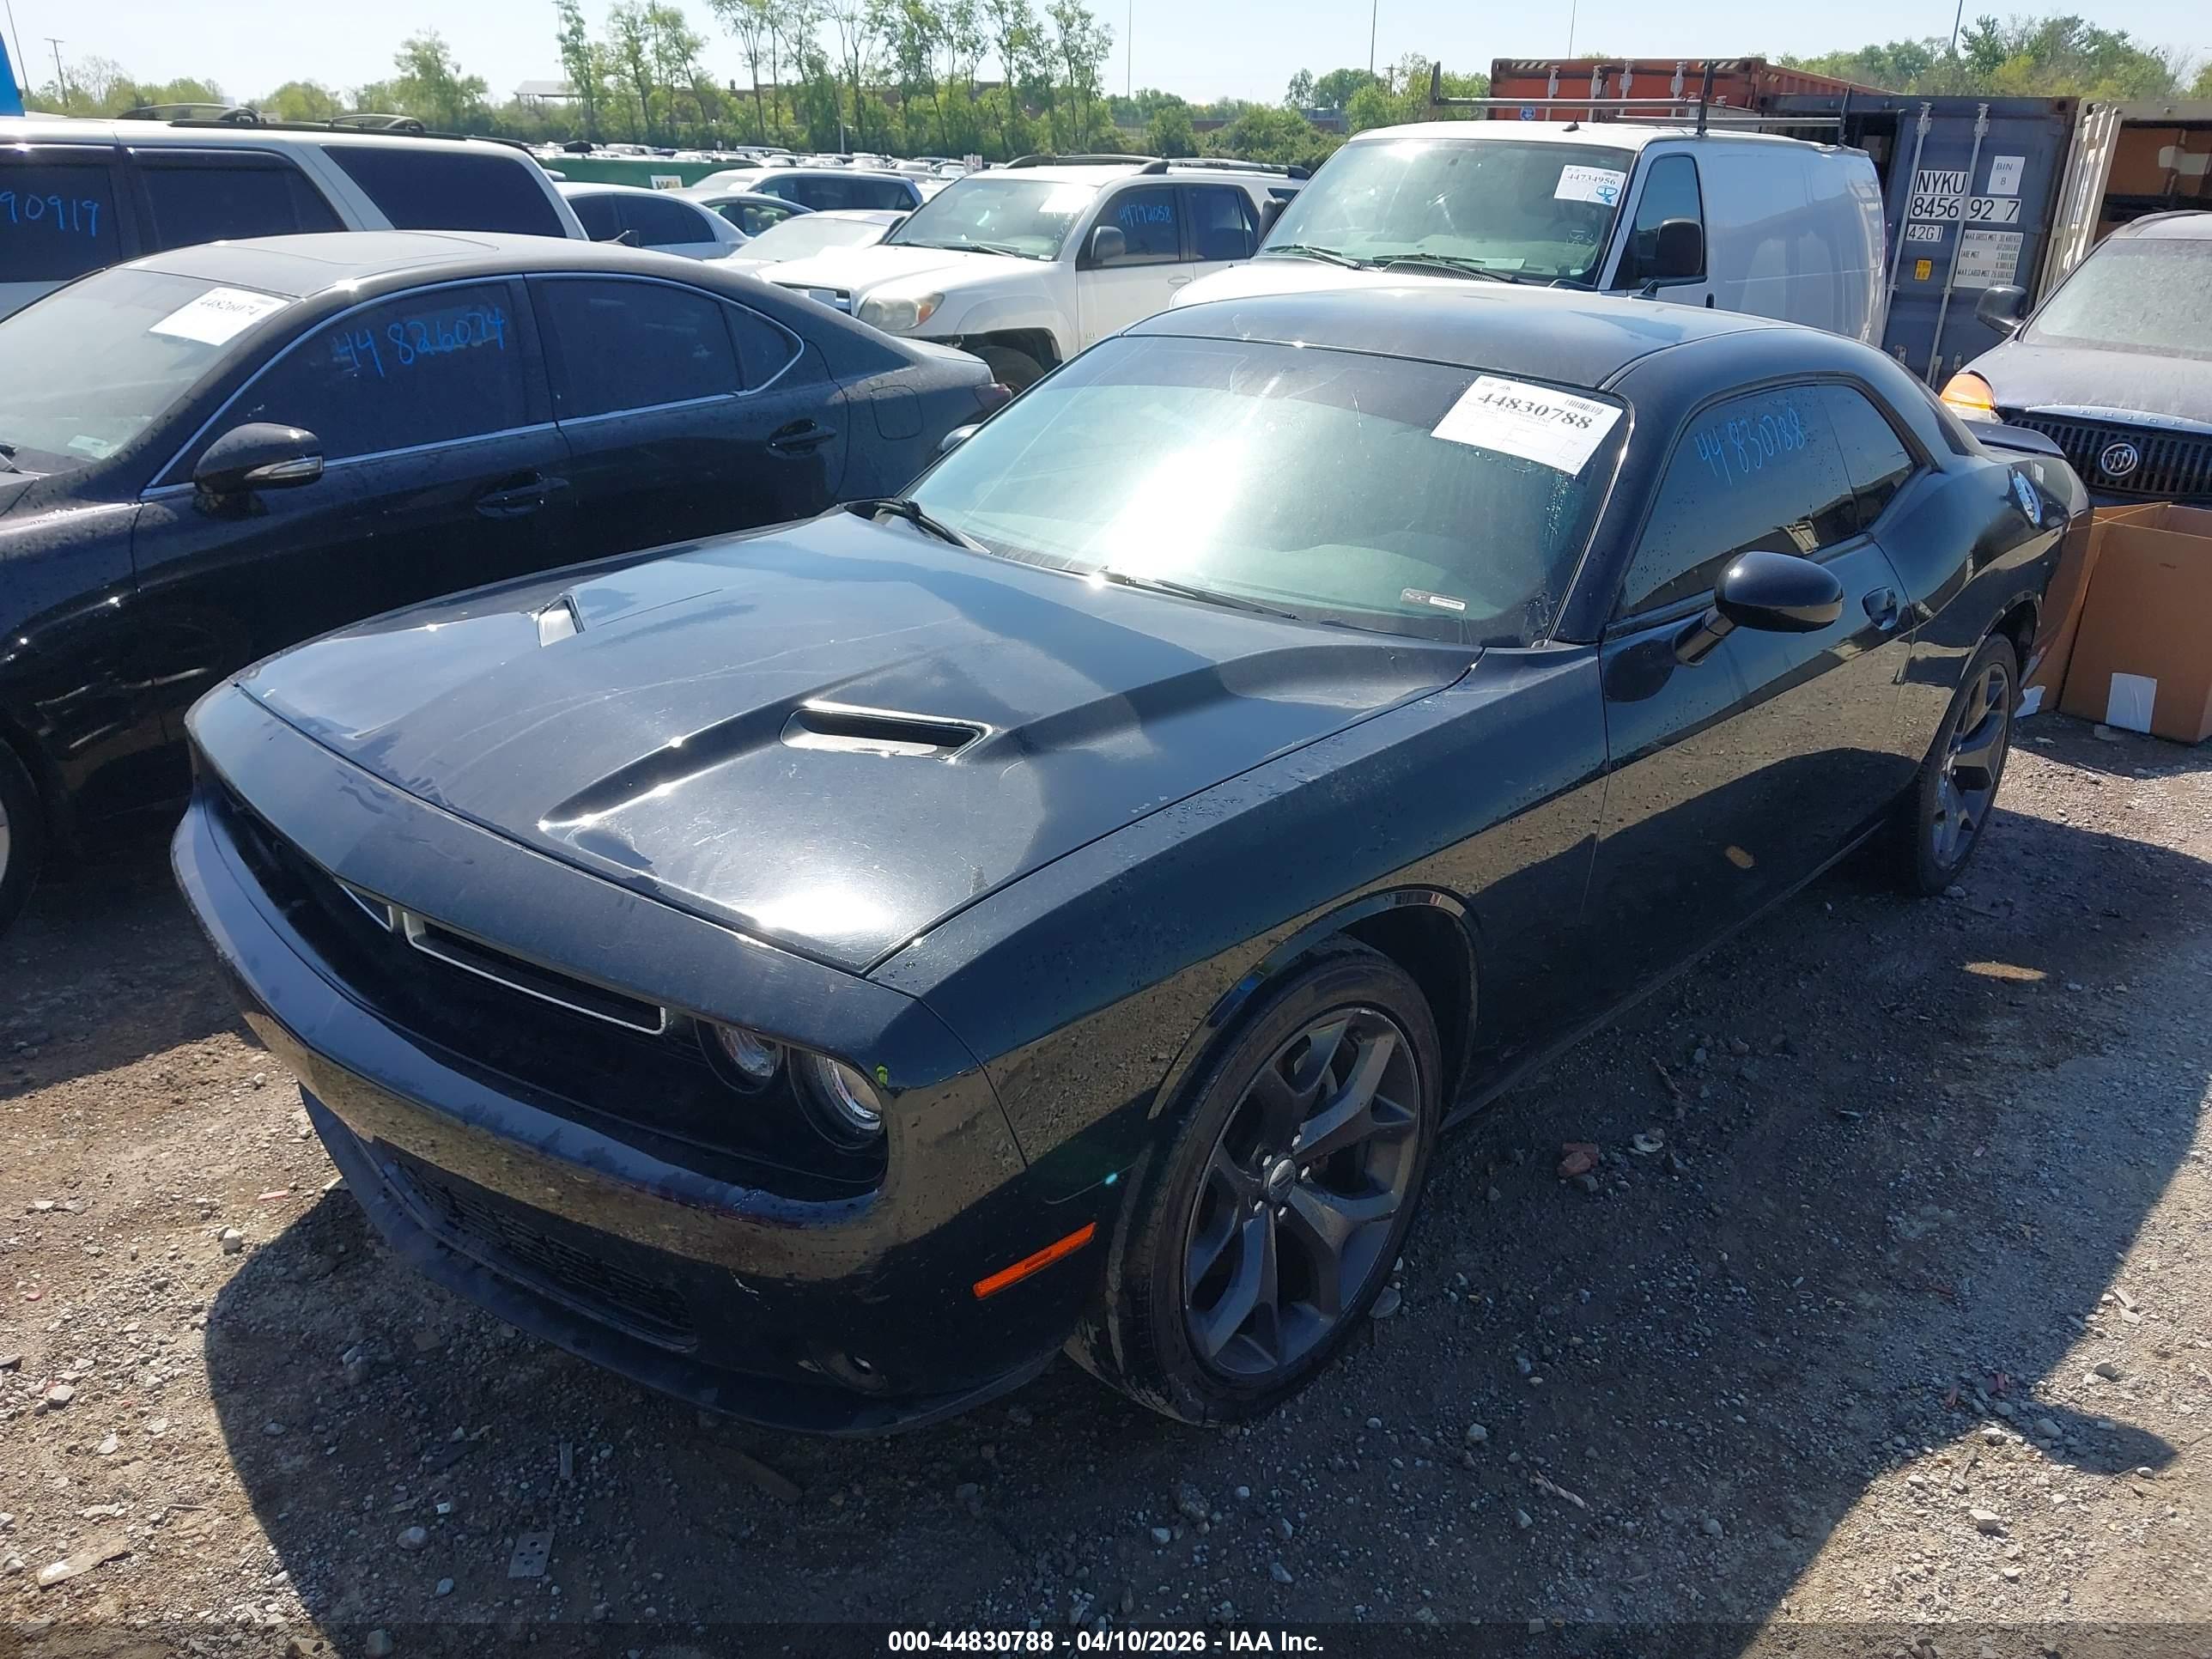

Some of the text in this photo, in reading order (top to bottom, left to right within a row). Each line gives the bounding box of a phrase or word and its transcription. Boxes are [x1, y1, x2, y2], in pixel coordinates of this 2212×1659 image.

[1996, 162, 2014, 171] BIN
[1566, 173, 1616, 185] 44734956
[1917, 171, 1967, 194] NYKU
[2000, 177, 2007, 185] 8
[2005, 200, 2019, 221] 7
[1908, 225, 1942, 240] 42G1
[1477, 392, 1594, 429] 44830788
